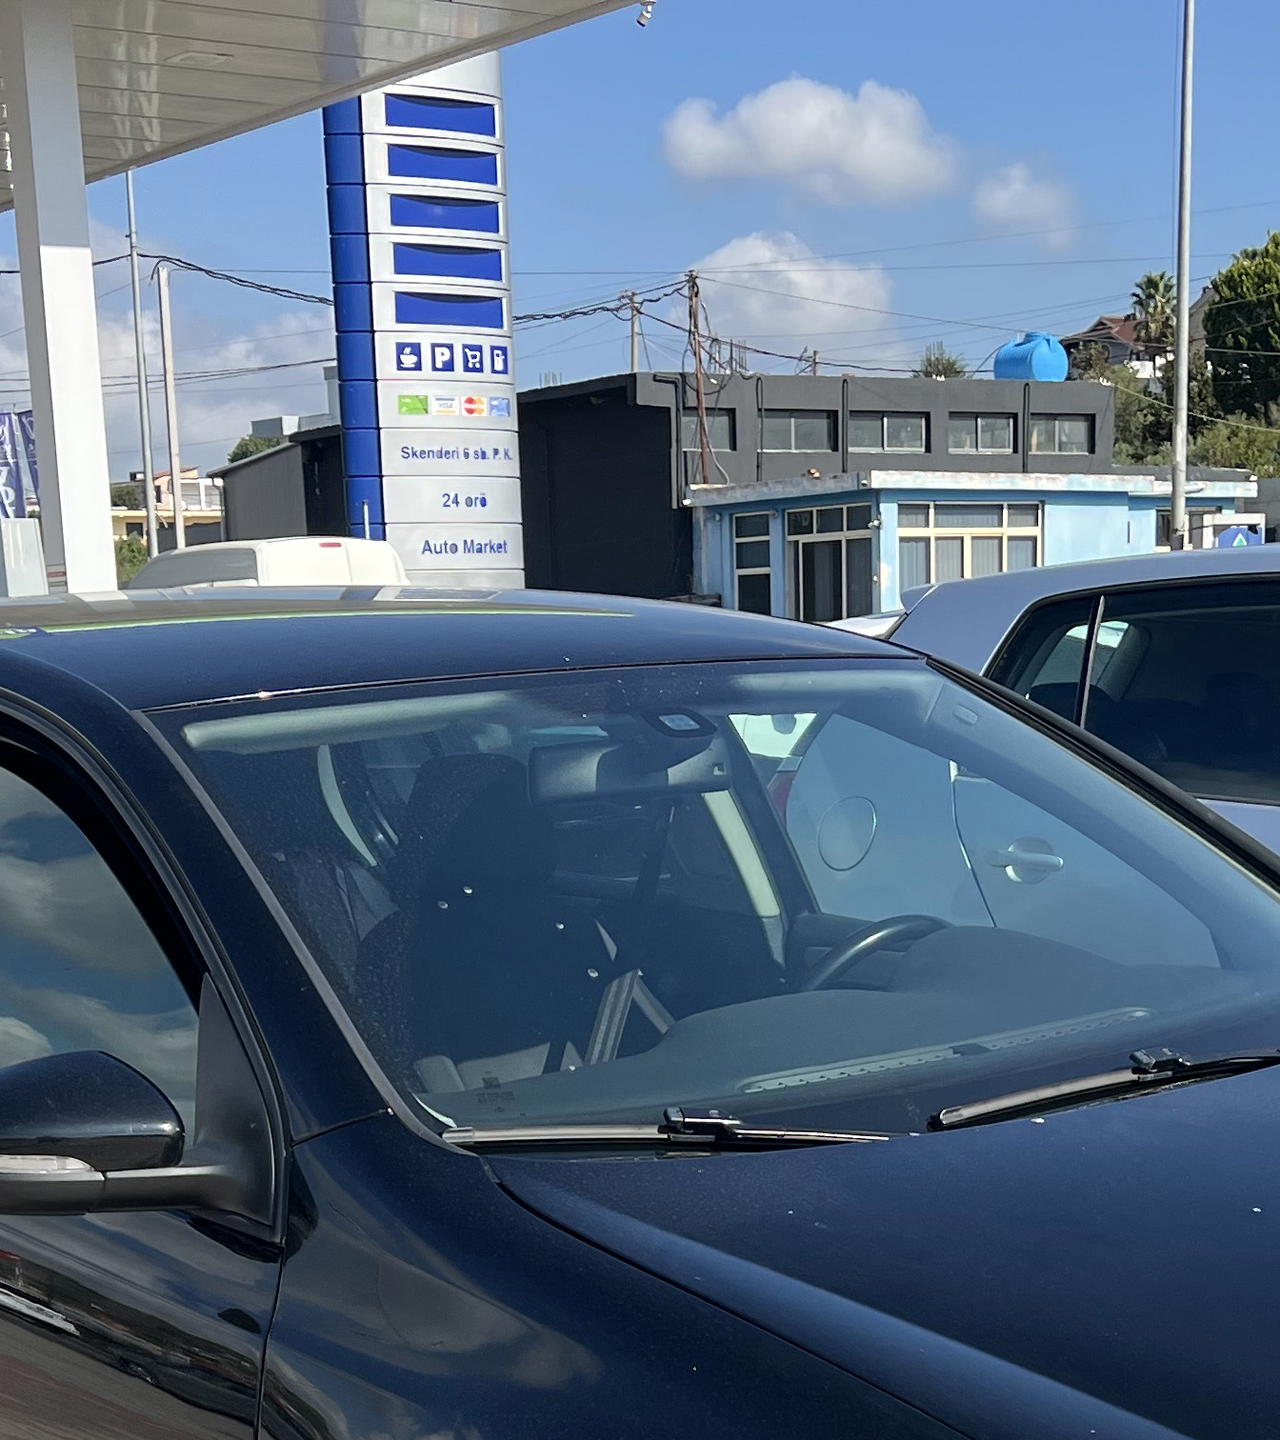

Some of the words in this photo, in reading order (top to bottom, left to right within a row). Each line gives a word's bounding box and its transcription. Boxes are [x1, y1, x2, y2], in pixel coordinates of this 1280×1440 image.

[400, 446, 460, 460] Skenderi
[442, 493, 460, 508] 24
[421, 539, 458, 555] Auto
[463, 538, 508, 554] Market
